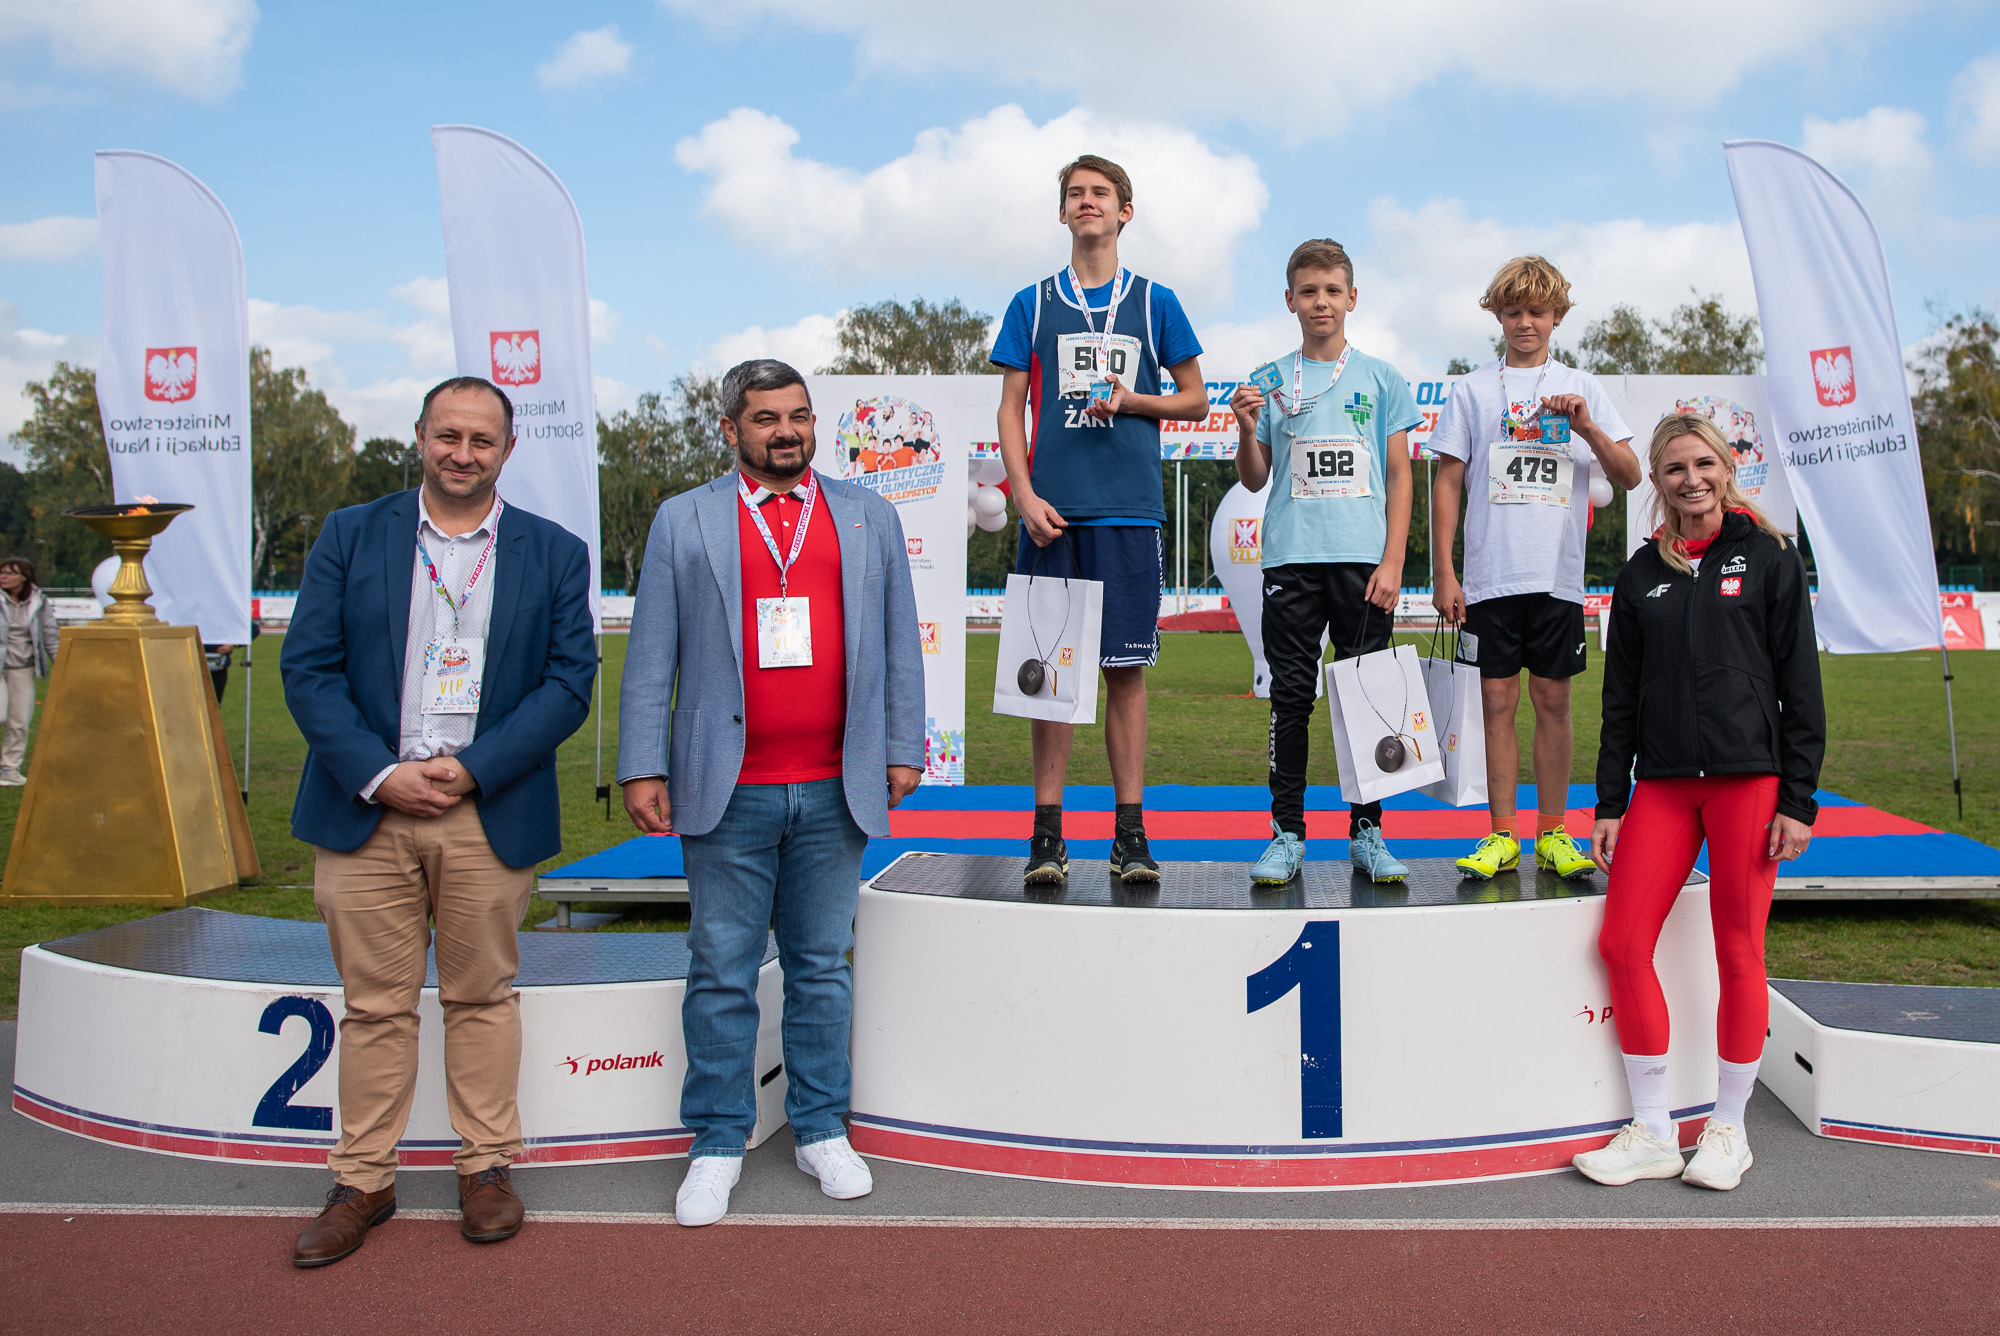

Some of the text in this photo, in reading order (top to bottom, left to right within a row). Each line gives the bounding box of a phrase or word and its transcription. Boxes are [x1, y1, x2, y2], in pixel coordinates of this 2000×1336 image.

[1306, 450, 1354, 478] 192
[1506, 456, 1558, 485] 479
[881, 475, 943, 494] OLIMPIJSKIE
[1231, 549, 1262, 562] PZLA
[440, 678, 464, 695] VIP
[1247, 920, 1343, 1138] 1
[251, 995, 336, 1131] 2
[585, 1050, 665, 1076] polanik
